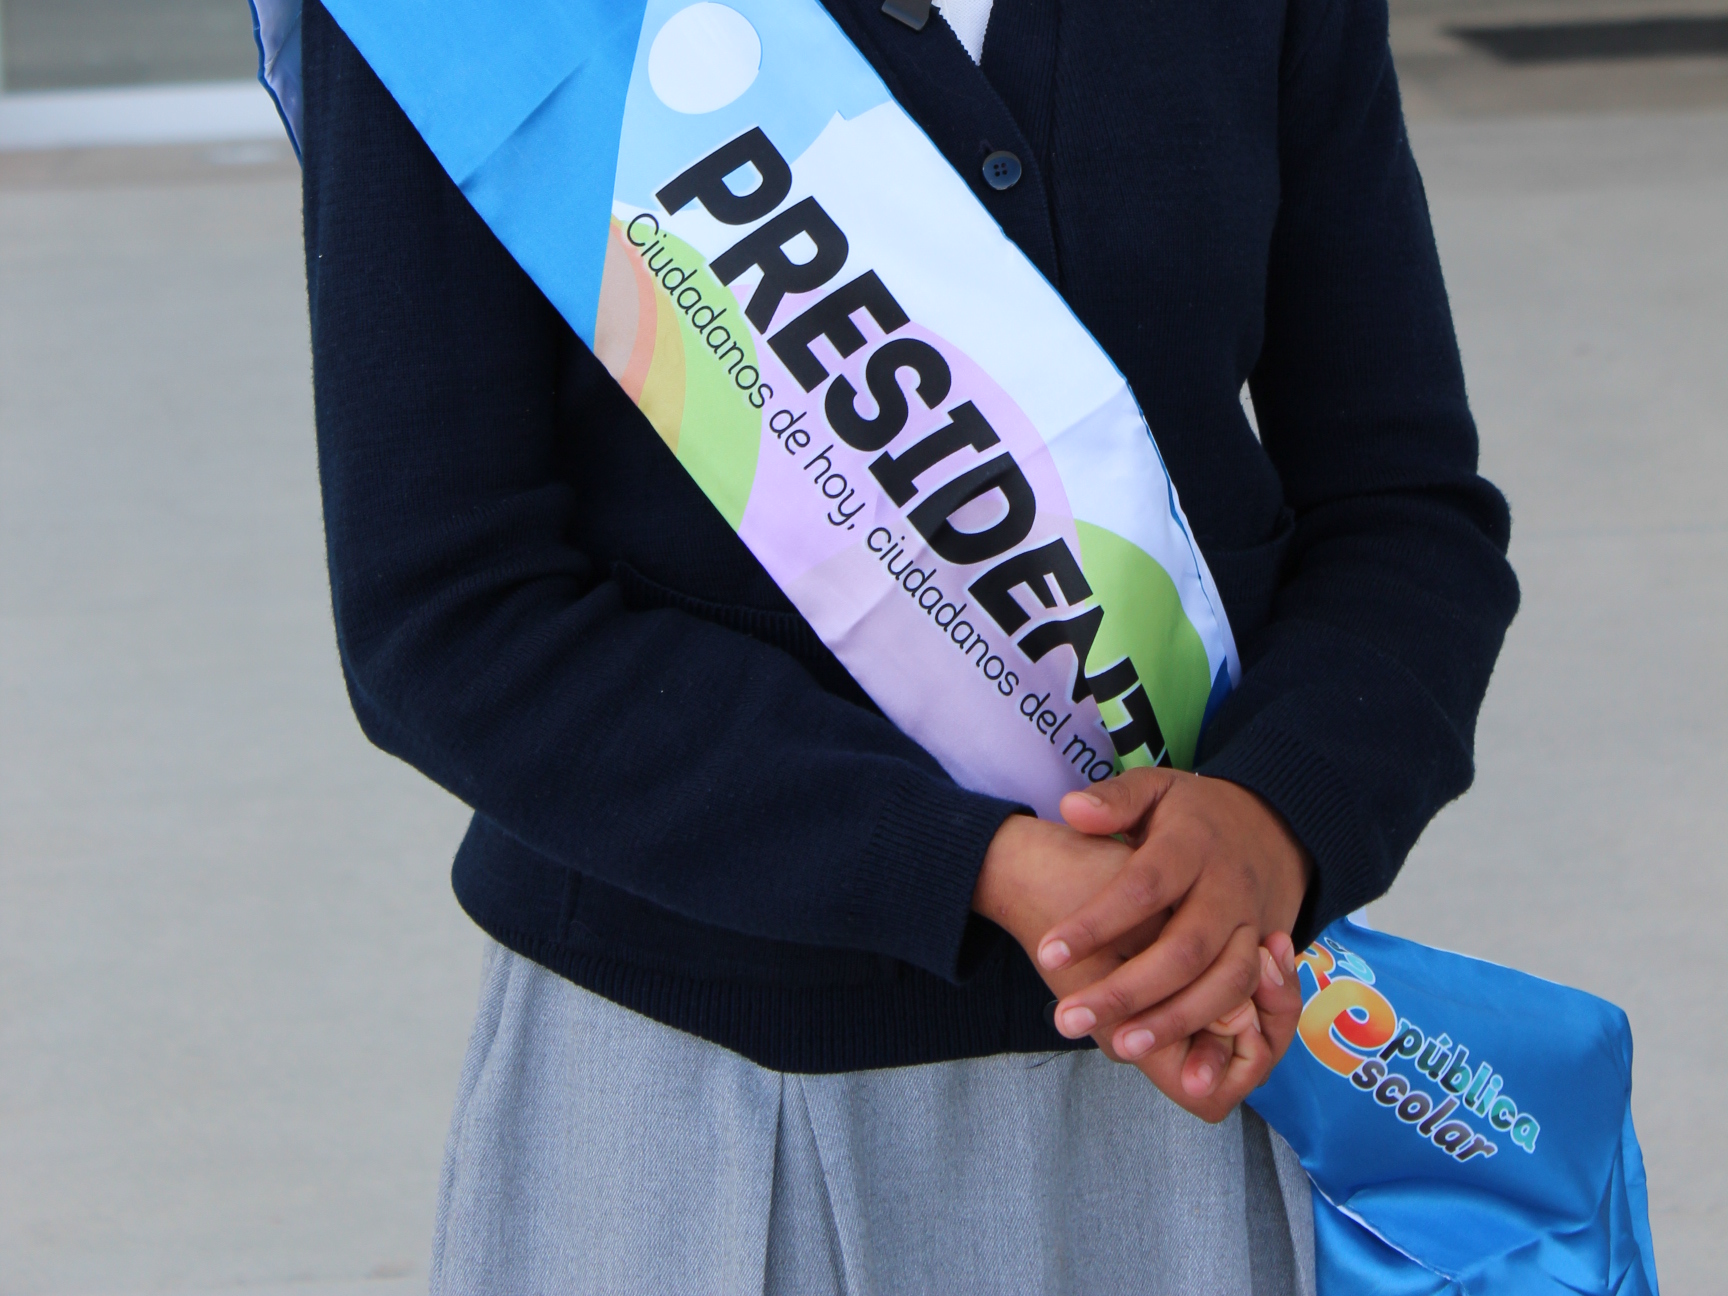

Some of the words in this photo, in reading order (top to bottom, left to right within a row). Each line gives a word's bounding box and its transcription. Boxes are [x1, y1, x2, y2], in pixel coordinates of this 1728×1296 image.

[626, 213, 774, 409] Ciudadanos
[769, 409, 811, 455] de
[803, 444, 866, 531] hoy,
[866, 527, 1019, 696] ciudadanos
[1020, 692, 1072, 744] del
[655, 125, 1173, 768] PRESIDENT
